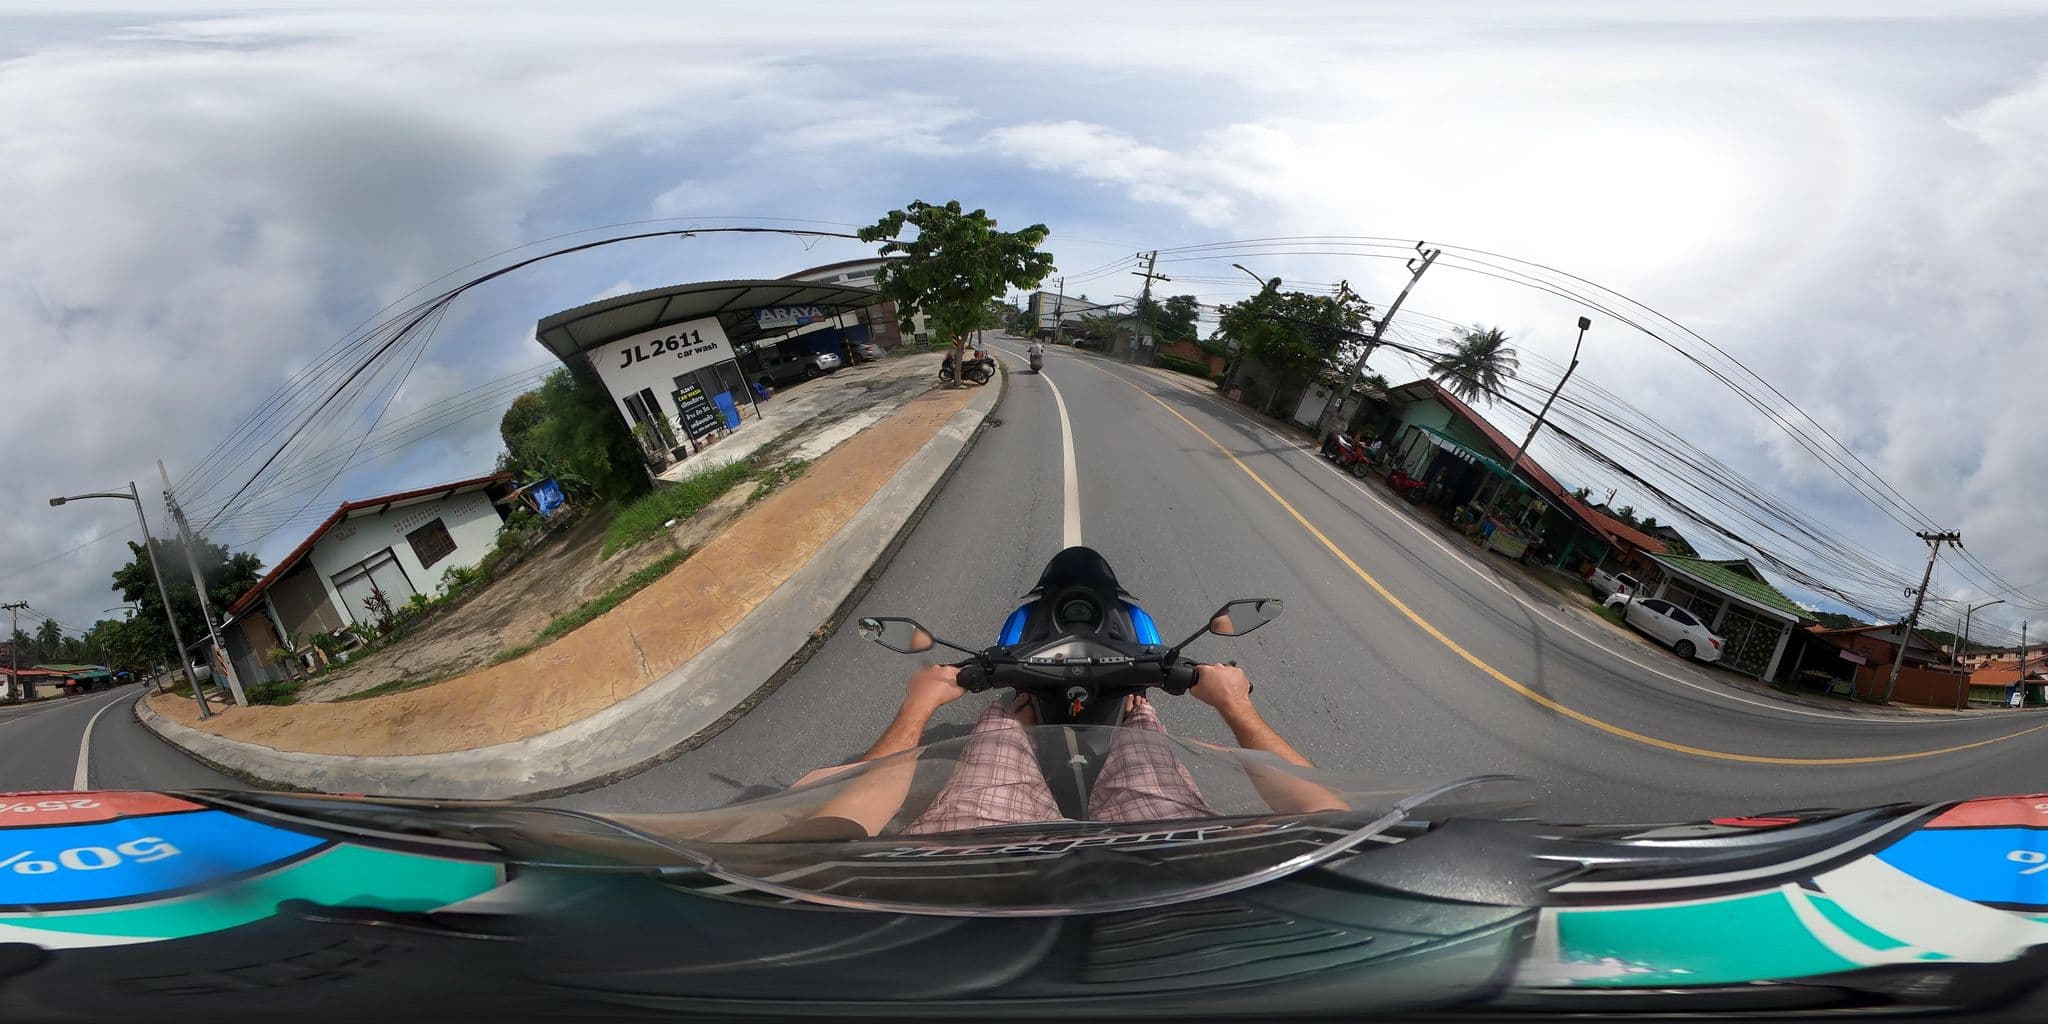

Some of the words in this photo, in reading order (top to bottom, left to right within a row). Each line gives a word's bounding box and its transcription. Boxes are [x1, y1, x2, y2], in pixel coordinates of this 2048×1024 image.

[760, 306, 822, 321] ARAYA
[620, 329, 703, 369] JL2611
[677, 349, 693, 359] car
[695, 342, 718, 354] wash
[0, 837, 182, 874] 50%
